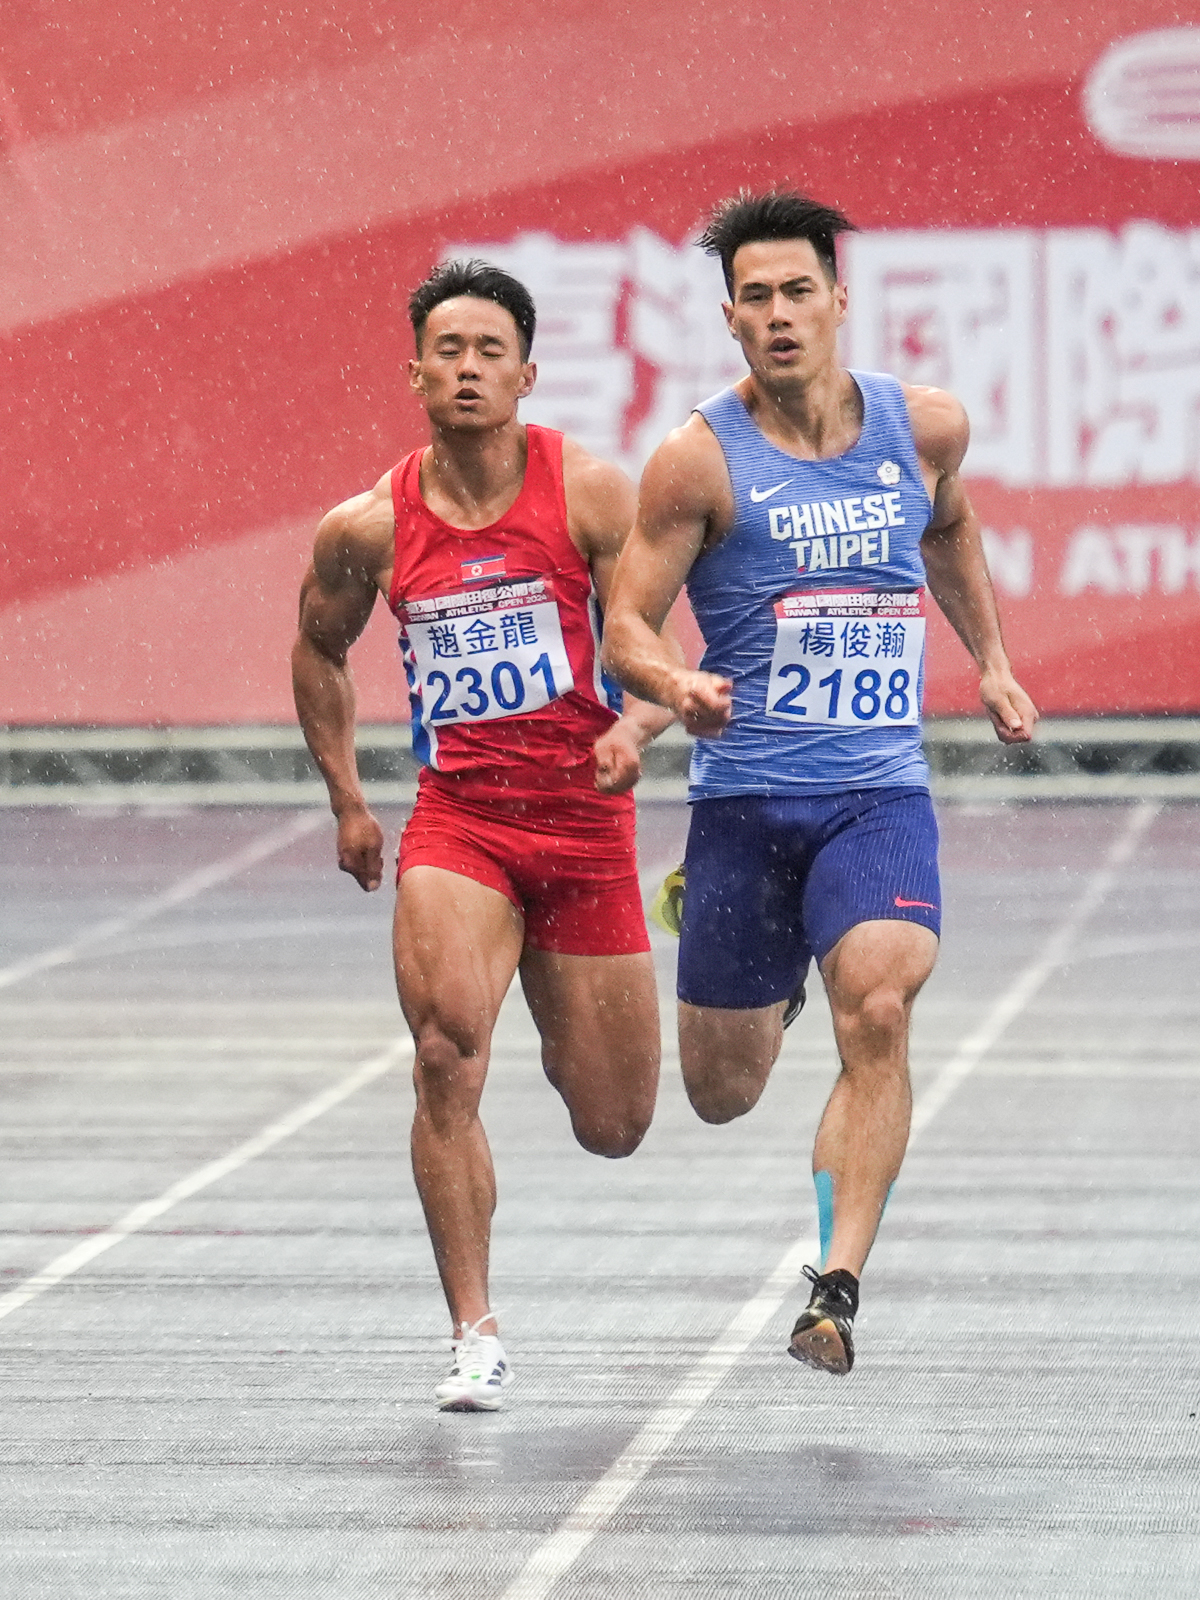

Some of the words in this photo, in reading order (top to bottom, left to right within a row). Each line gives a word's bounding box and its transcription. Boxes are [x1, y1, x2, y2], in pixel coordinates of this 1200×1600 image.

[768, 491, 906, 541] CHINESE
[789, 530, 890, 573] TAIPEI
[445, 602, 494, 618] ATHLETICS
[498, 598, 524, 609] OPEN
[526, 593, 548, 604] 2024
[783, 608, 820, 617] TAIWAN
[827, 607, 873, 616] ATHLETICS
[877, 607, 901, 616] OPEN
[902, 607, 920, 615] 2024
[427, 611, 539, 660] 趙金龍
[799, 622, 906, 659] 楊俊瀚
[426, 652, 560, 721] 2301
[773, 664, 910, 721] 2188
